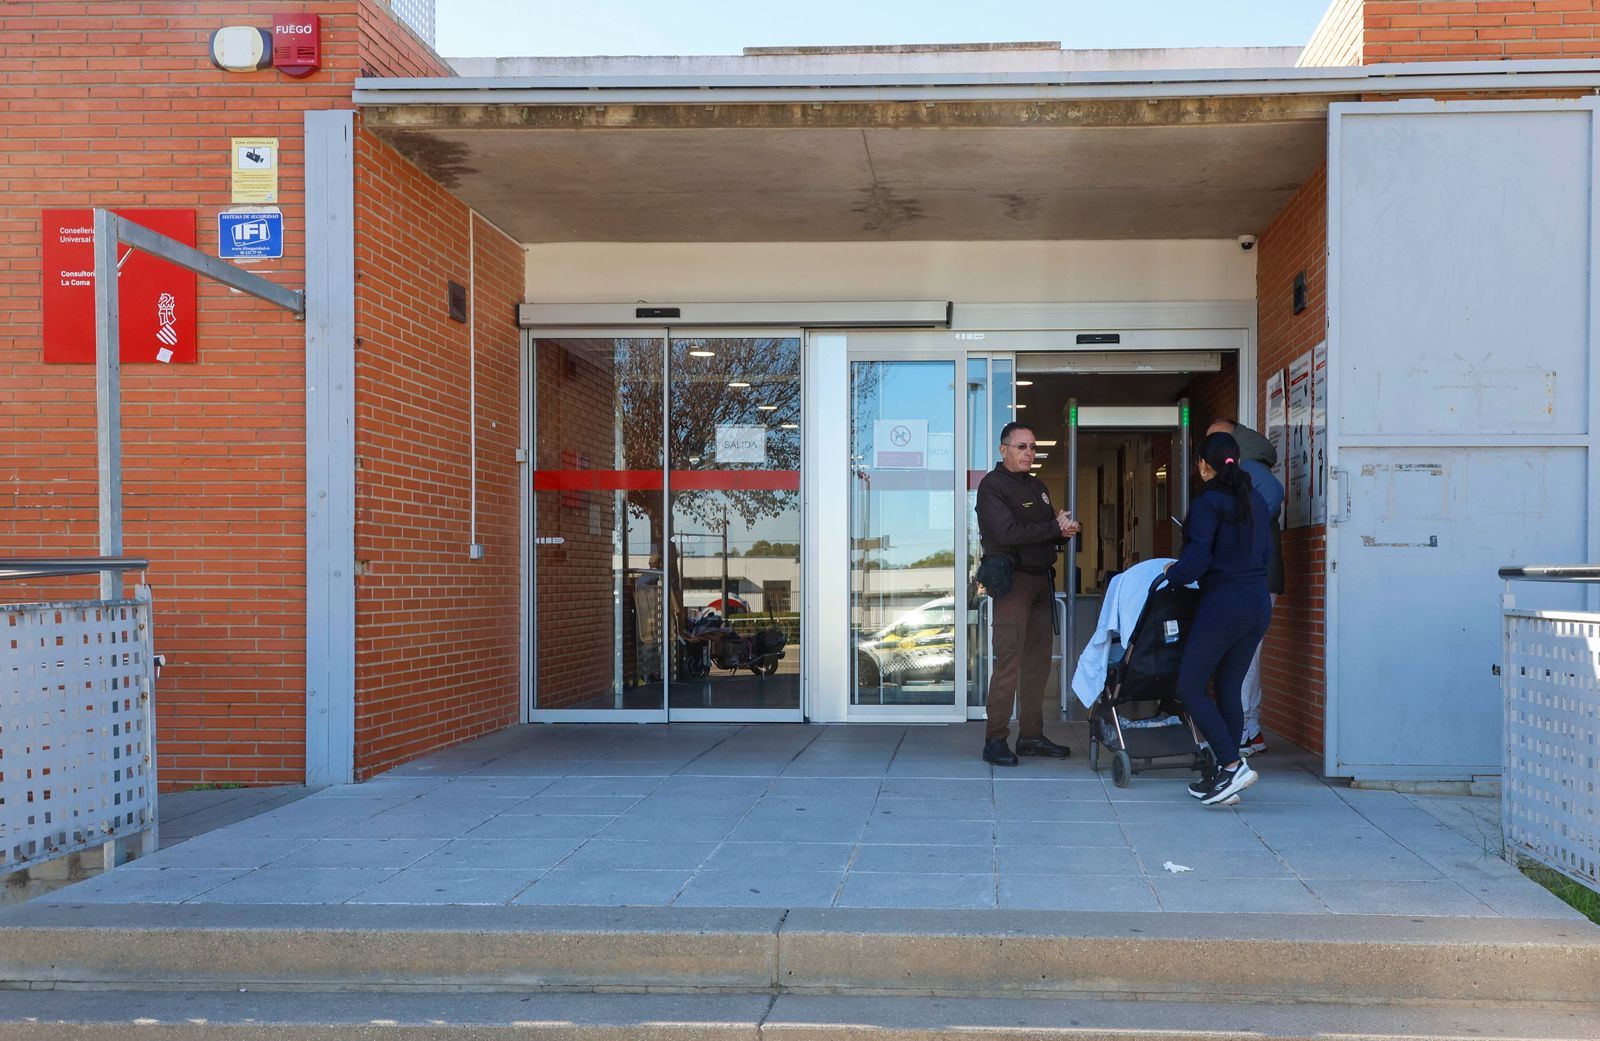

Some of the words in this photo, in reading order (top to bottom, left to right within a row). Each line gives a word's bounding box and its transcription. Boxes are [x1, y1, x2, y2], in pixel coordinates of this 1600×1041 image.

[276, 24, 312, 34] FUEGO
[235, 223, 267, 240] IFI
[60, 235, 91, 243] Universal
[724, 440, 758, 449] SALIDA
